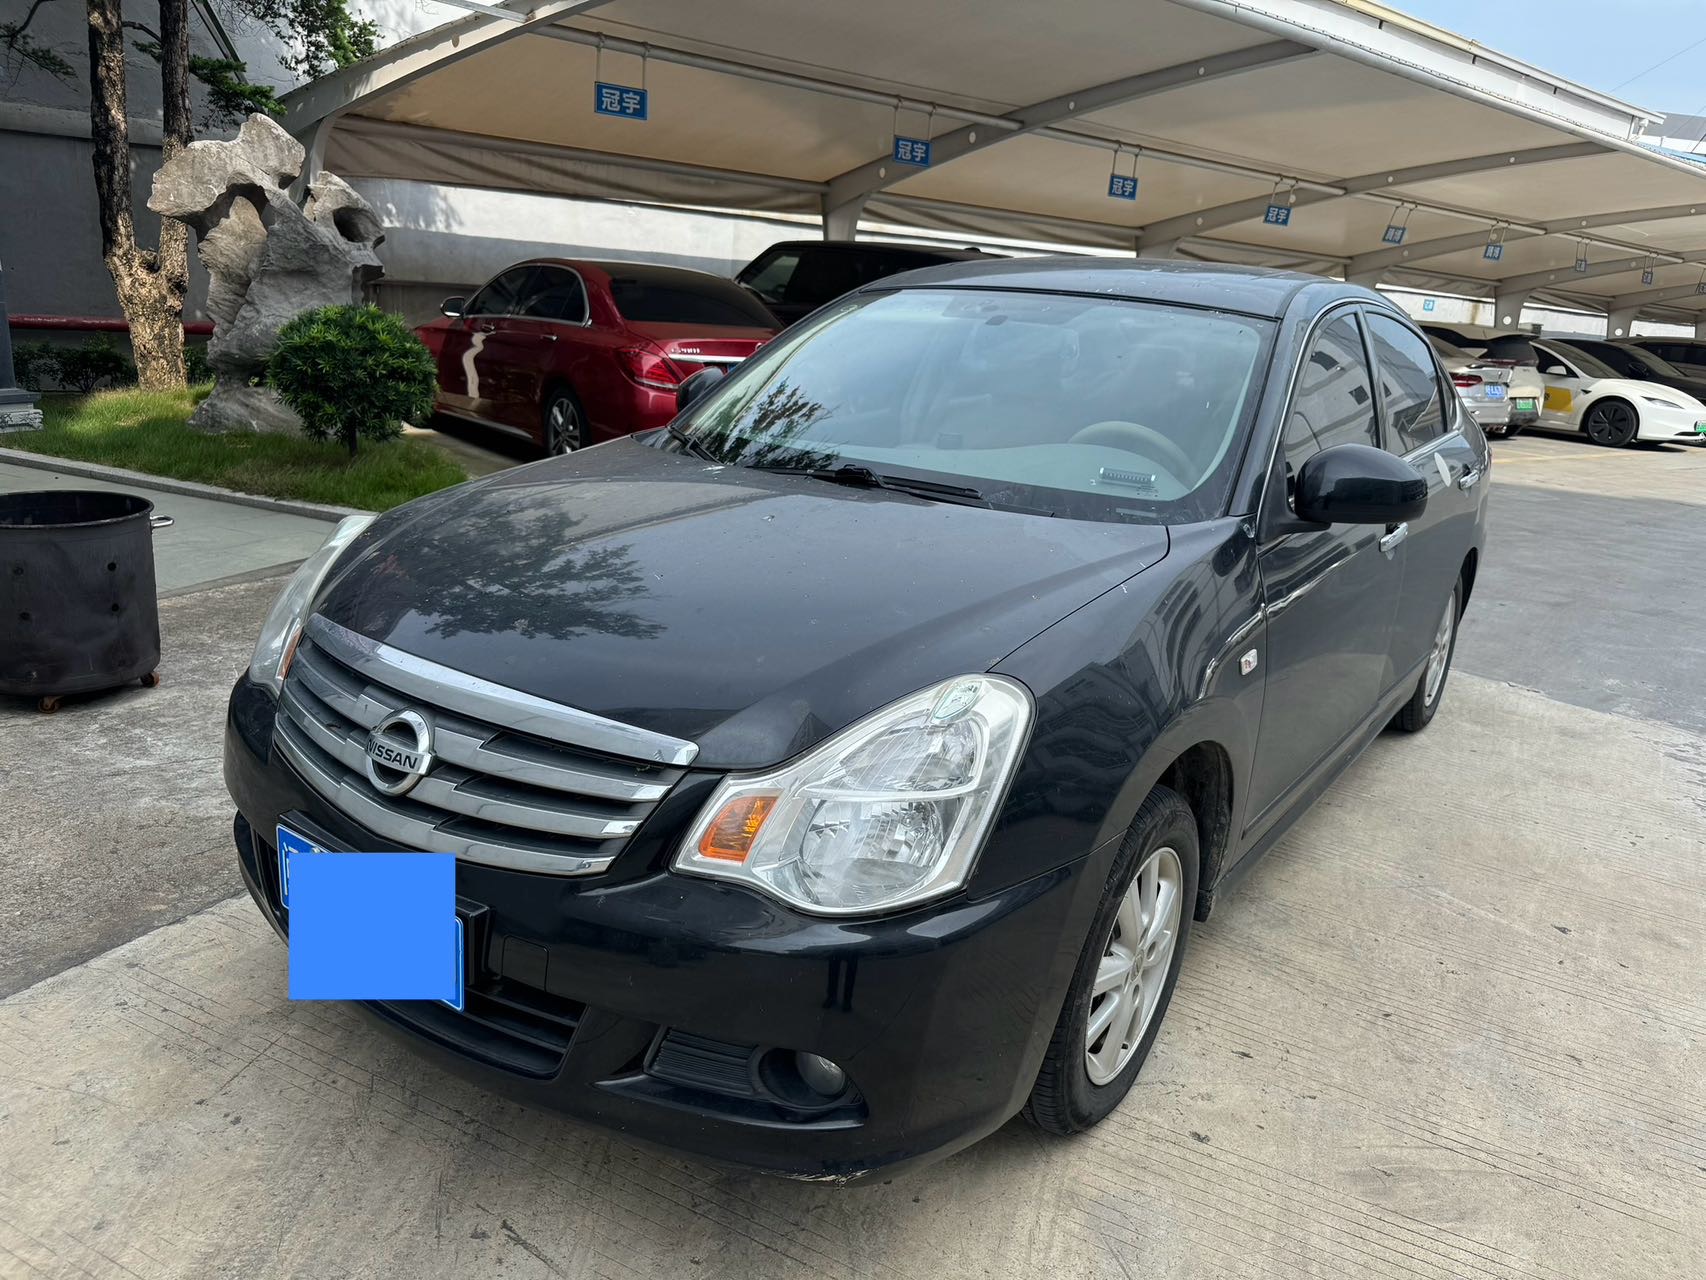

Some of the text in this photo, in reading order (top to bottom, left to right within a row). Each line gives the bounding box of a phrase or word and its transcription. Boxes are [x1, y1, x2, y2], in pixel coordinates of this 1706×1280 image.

[602, 89, 641, 113] 冠宇
[898, 141, 926, 161] 冠宇
[1112, 178, 1134, 195] 冠宇
[367, 738, 418, 769] NISSAN
